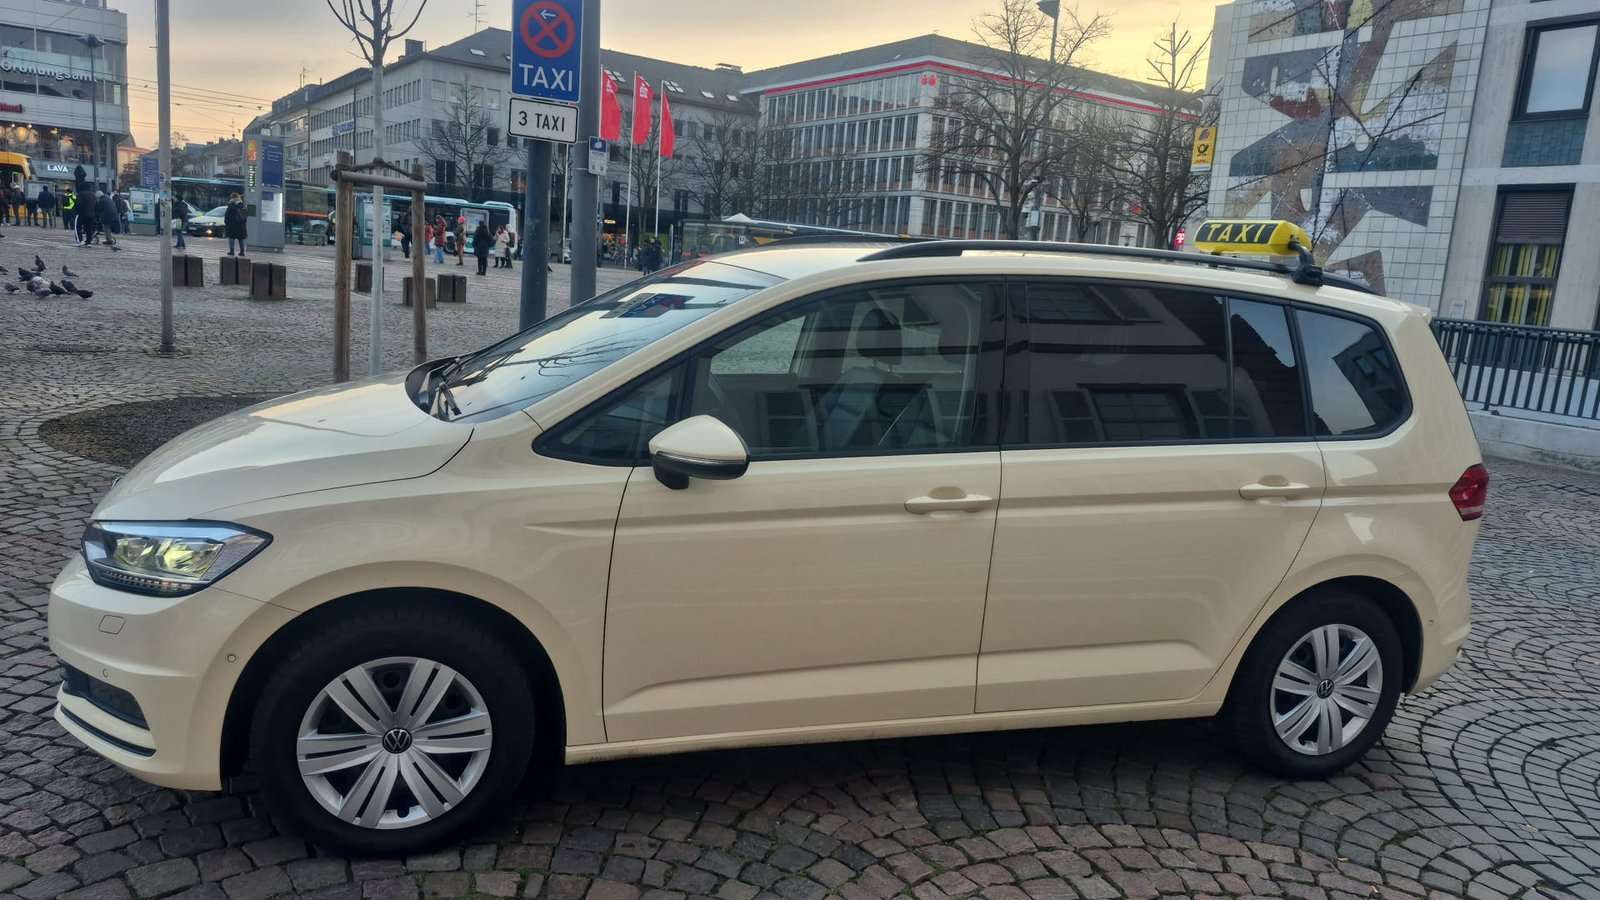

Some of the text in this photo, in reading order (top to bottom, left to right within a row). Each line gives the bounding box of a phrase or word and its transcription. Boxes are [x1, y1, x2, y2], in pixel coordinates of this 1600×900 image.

[518, 63, 573, 92] TAXI
[518, 110, 565, 132] 3 TAXI
[47, 164, 69, 173] LAVA
[1207, 223, 1266, 242] TAXI
